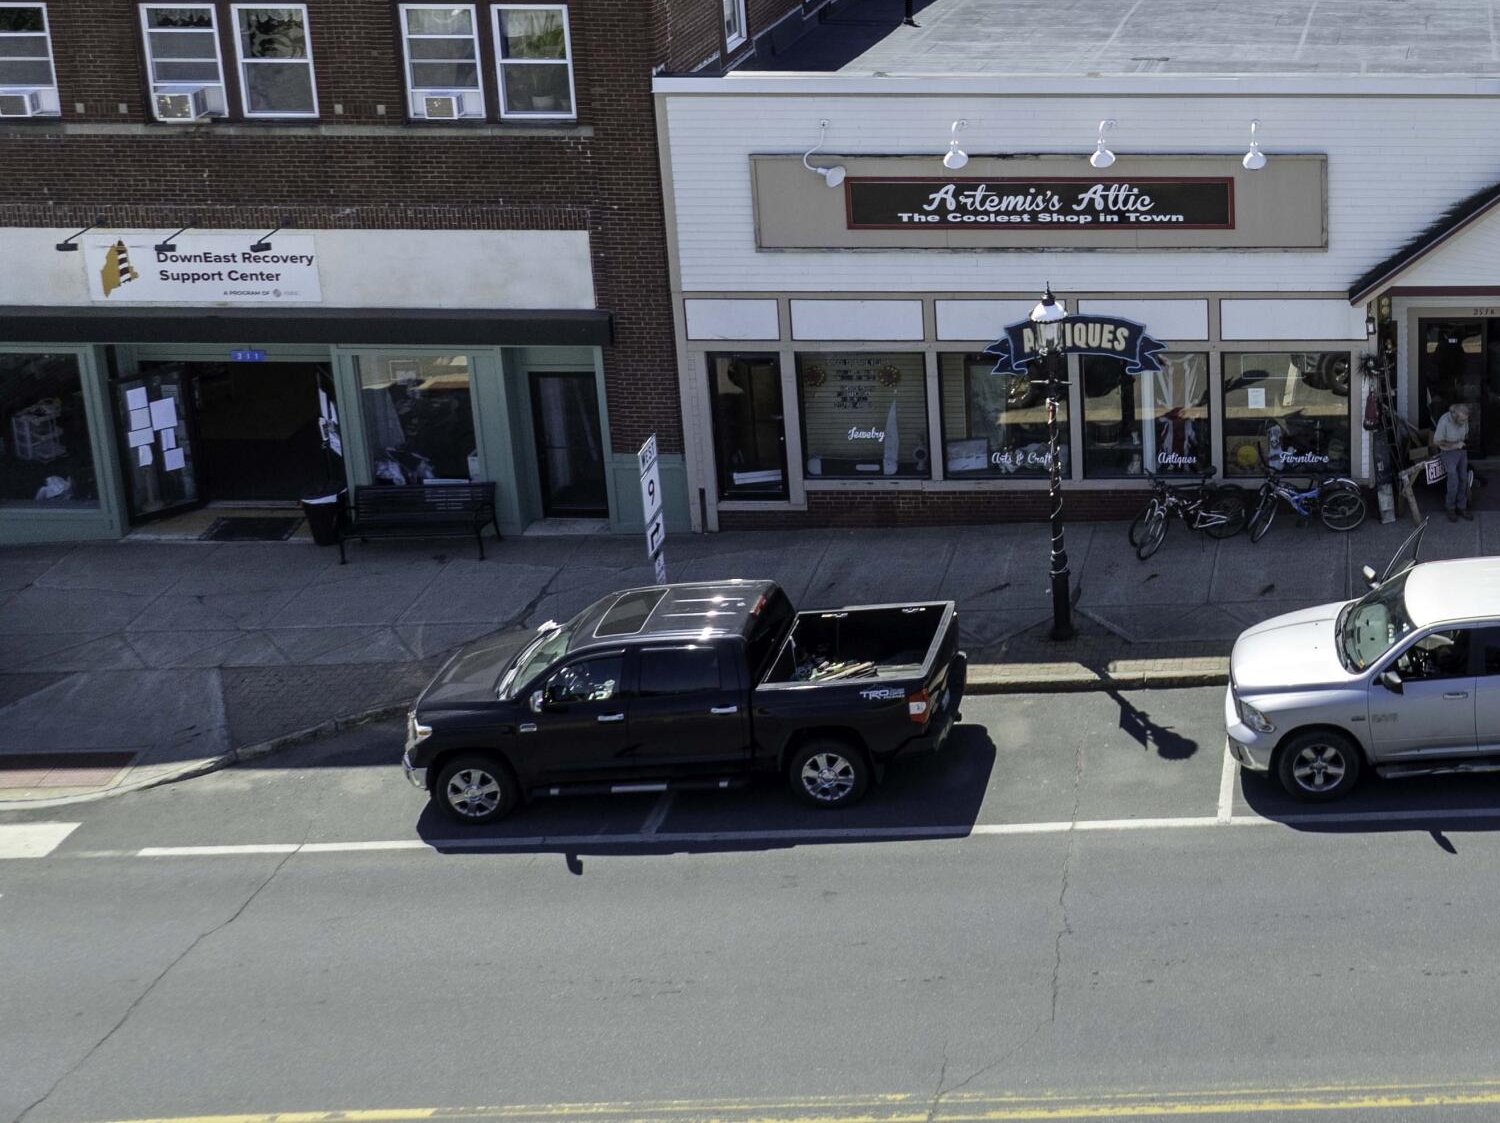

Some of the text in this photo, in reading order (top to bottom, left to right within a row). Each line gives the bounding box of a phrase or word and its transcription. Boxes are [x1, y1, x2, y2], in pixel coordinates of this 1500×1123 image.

[922, 183, 1155, 212] Artemis's Attic
[898, 212, 1184, 224] The Coolest Shop in Town
[157, 252, 314, 266] DownEast Recovery
[159, 270, 281, 284] Support Center
[1022, 322, 1130, 354] AIQUES
[848, 426, 885, 442] Jewelry
[641, 441, 655, 469] WEST
[991, 452, 1012, 464] Arts
[1027, 452, 1053, 465] Craft
[1158, 452, 1197, 467] Antiques
[1279, 451, 1329, 463] Furniture
[647, 479, 655, 506] 9
